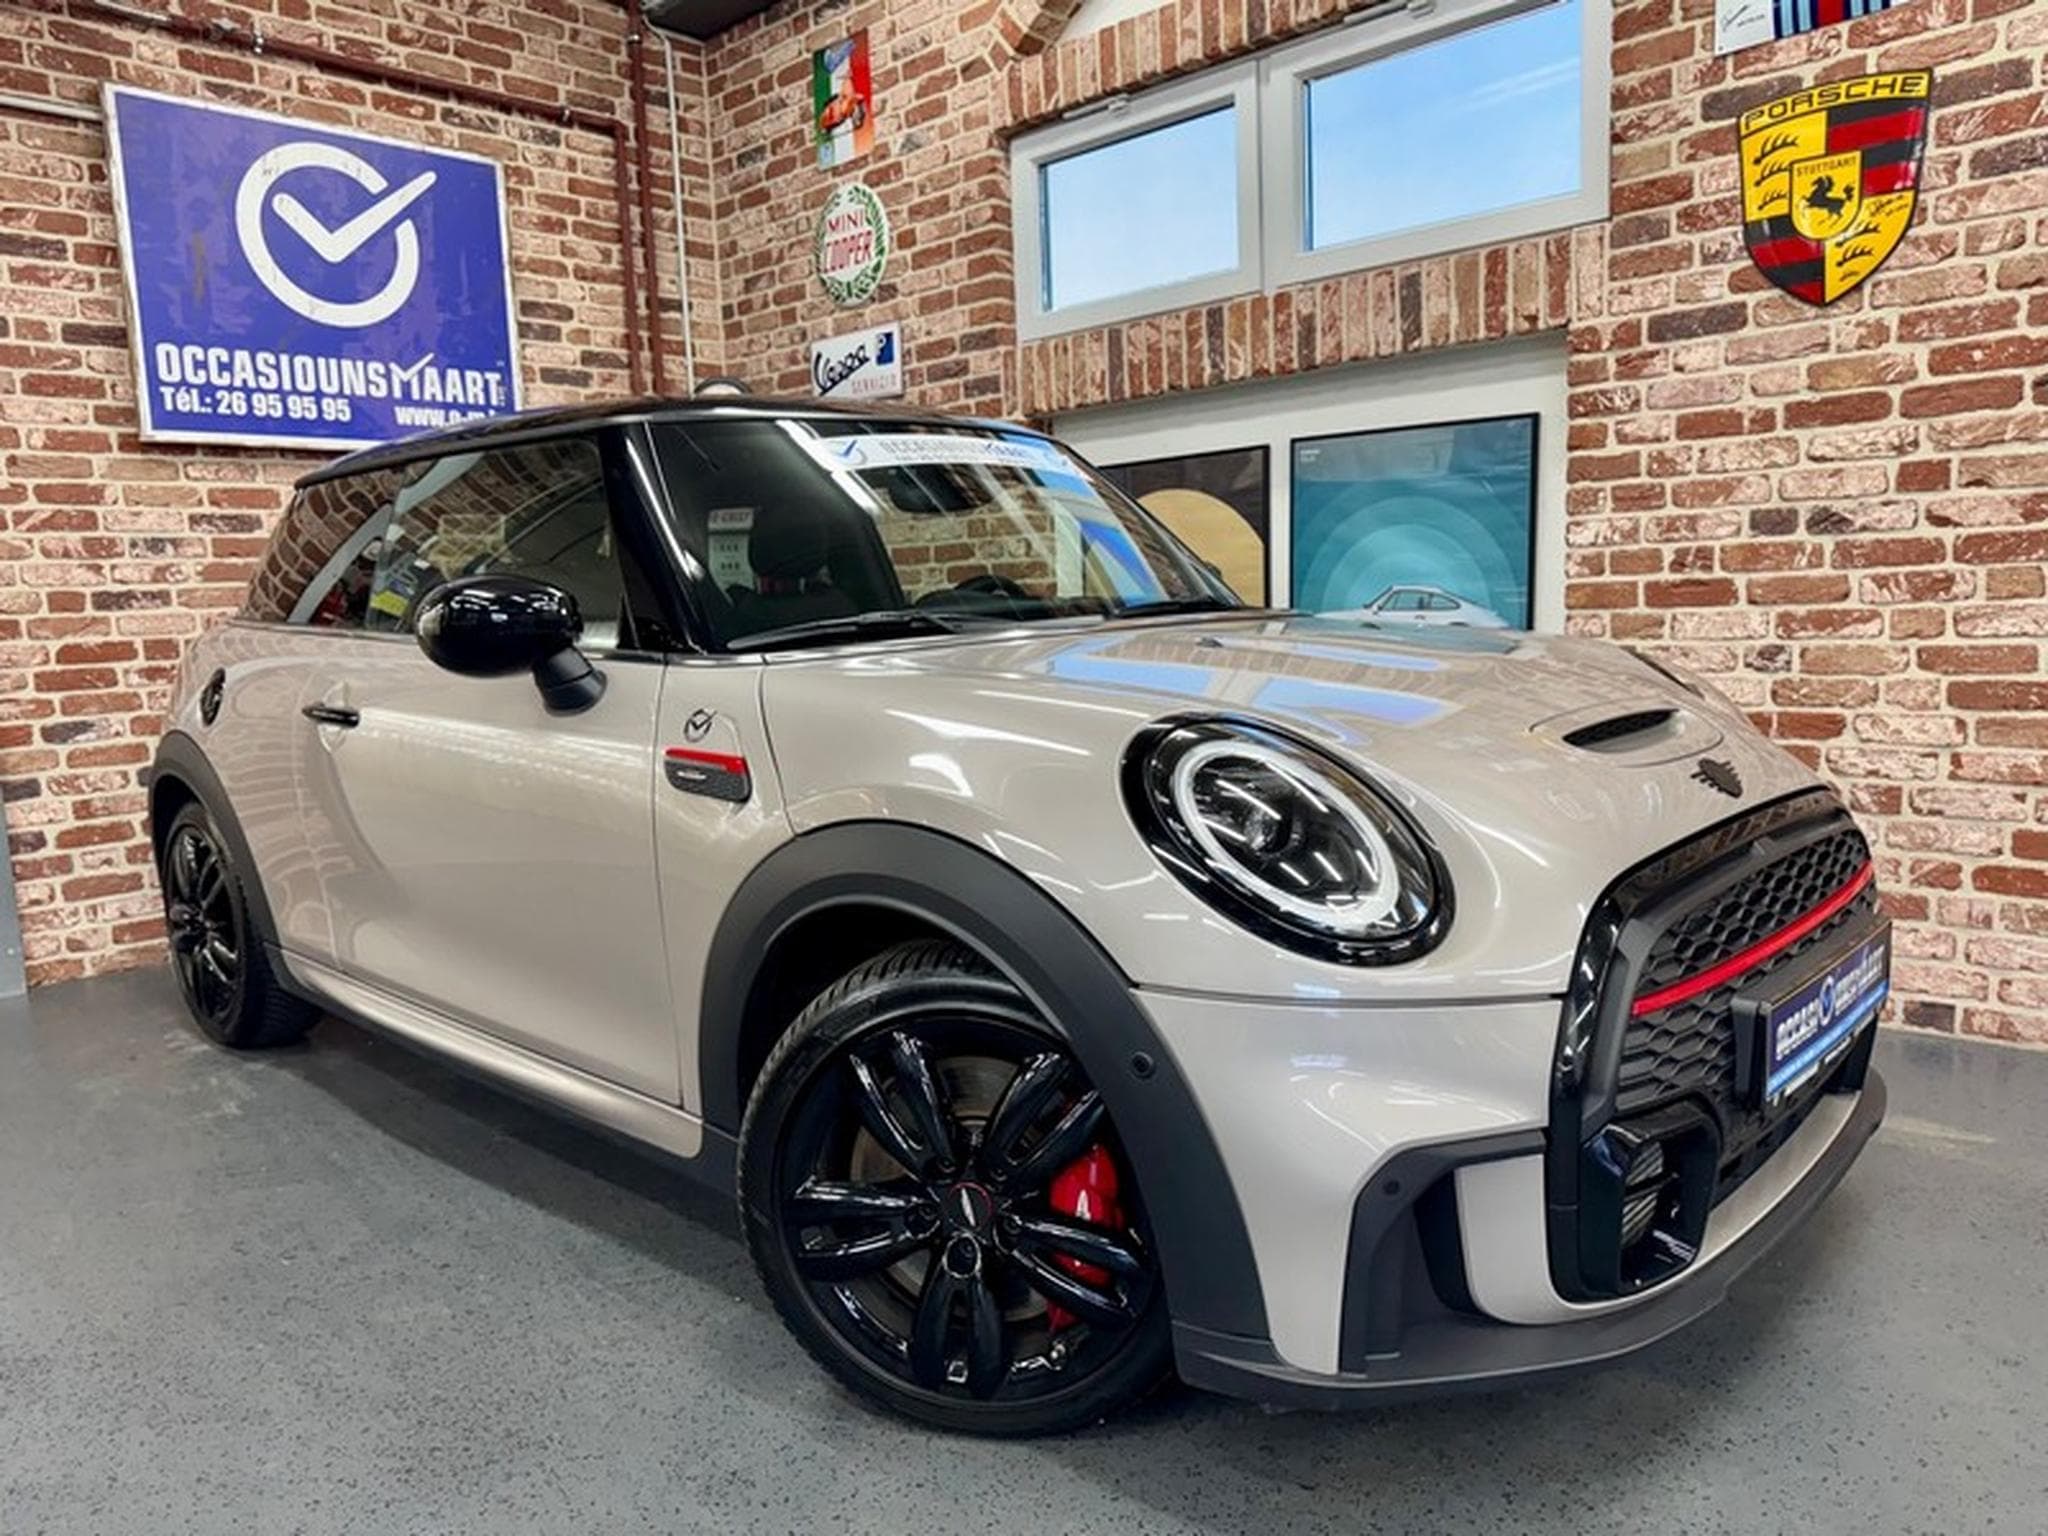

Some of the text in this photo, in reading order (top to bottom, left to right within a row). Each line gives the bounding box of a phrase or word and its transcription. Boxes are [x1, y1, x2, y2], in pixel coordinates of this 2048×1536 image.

[1744, 74, 1925, 131] PORSCHE
[827, 208, 864, 233] MINI
[155, 342, 501, 407] OCCASIOUNSMAART
[215, 389, 248, 417] 26
[251, 392, 284, 419] 95
[287, 394, 318, 421] 95
[321, 396, 352, 423] 95
